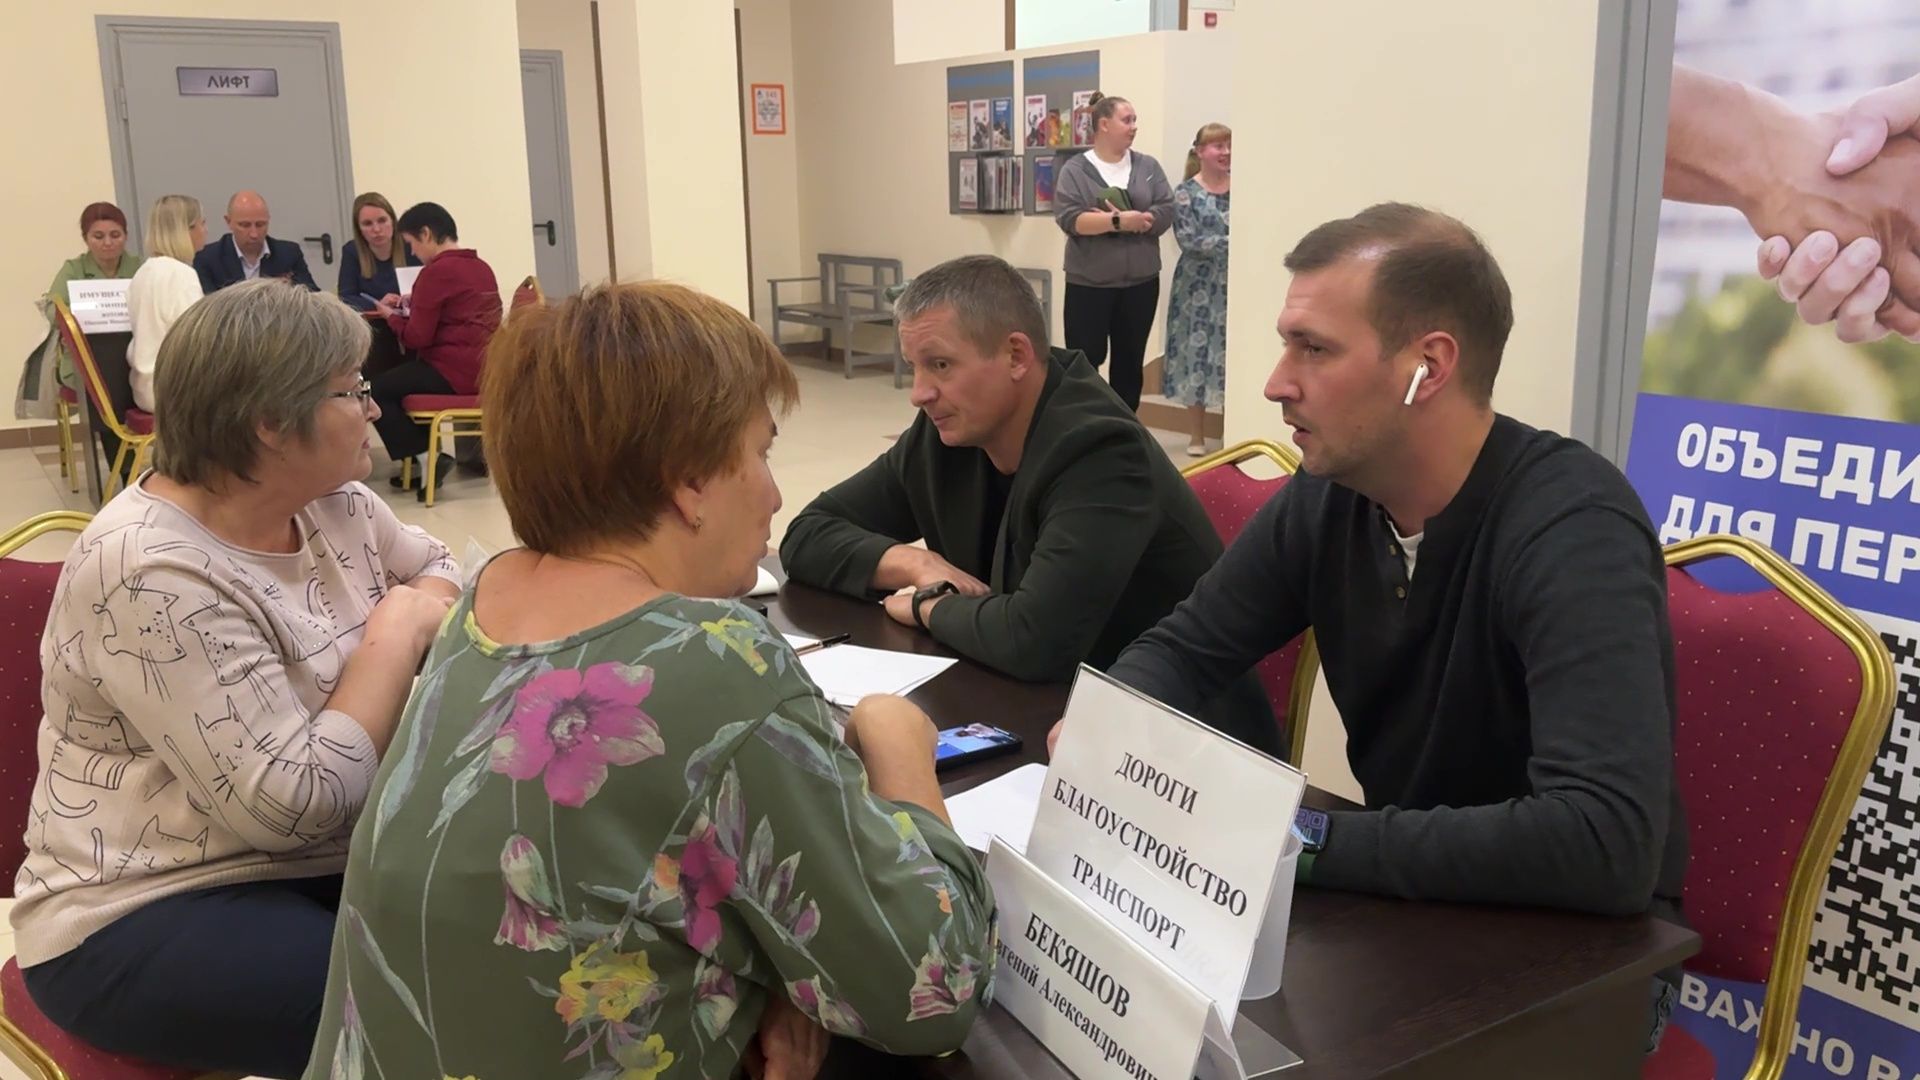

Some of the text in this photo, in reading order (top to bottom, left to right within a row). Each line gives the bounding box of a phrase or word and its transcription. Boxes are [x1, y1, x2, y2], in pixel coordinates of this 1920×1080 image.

[207, 75, 250, 89] ЛИФТ
[1676, 422, 1920, 506] ОБЪЕДИ
[1658, 494, 1920, 584] ДЛЯ ПЕР
[1114, 751, 1199, 815] ДОРОГИ
[1052, 777, 1247, 917] БЛАГОУСТРОЙСТВО
[1071, 854, 1186, 951] ТРАНСПОРТ
[996, 938, 1040, 988] вгений
[1024, 912, 1130, 1018] БЕКЯШОВ
